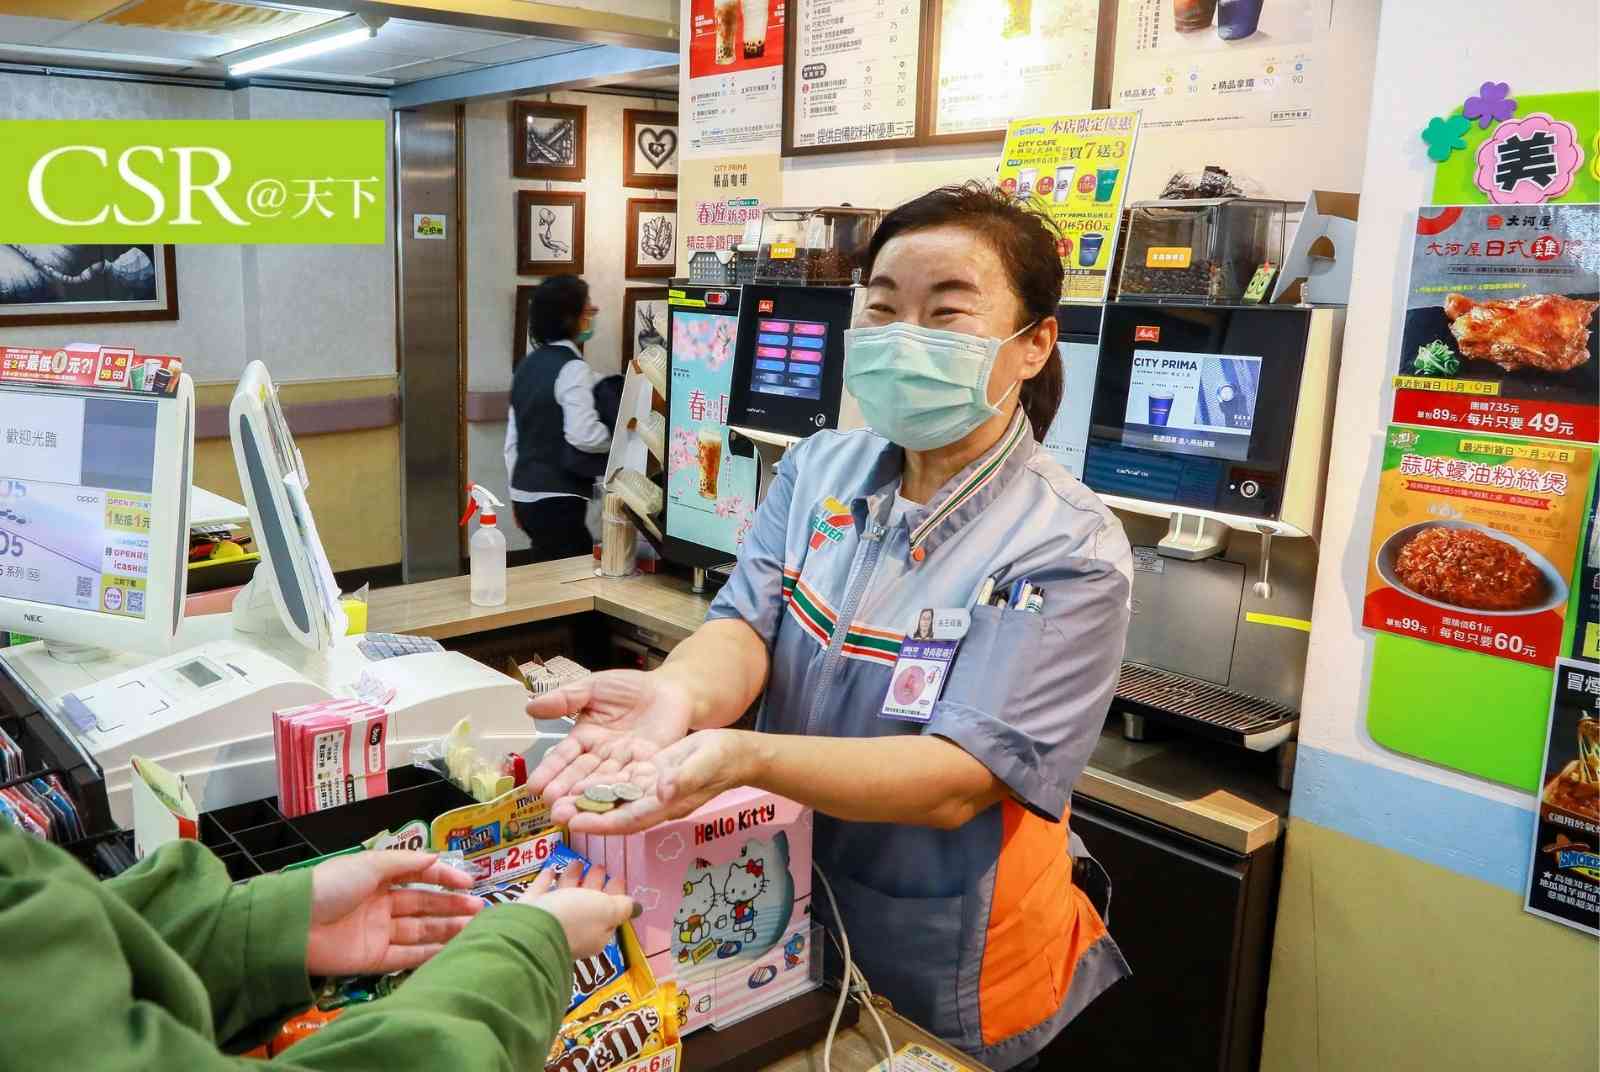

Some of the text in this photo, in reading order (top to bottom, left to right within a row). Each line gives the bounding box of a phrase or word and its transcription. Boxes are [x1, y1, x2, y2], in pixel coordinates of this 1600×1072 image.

[1494, 131, 1558, 192] 美
[1506, 215, 1552, 231] 大河屋
[1134, 357, 1198, 371] CITY PRIMA
[6, 428, 57, 448] 歡迎光臨
[1402, 455, 1568, 495] 蒜味蠔油粉絲煲
[24, 614, 44, 623] NEC
[1440, 627, 1537, 658] 每包只要60元
[694, 803, 775, 846] Hello Kitty
